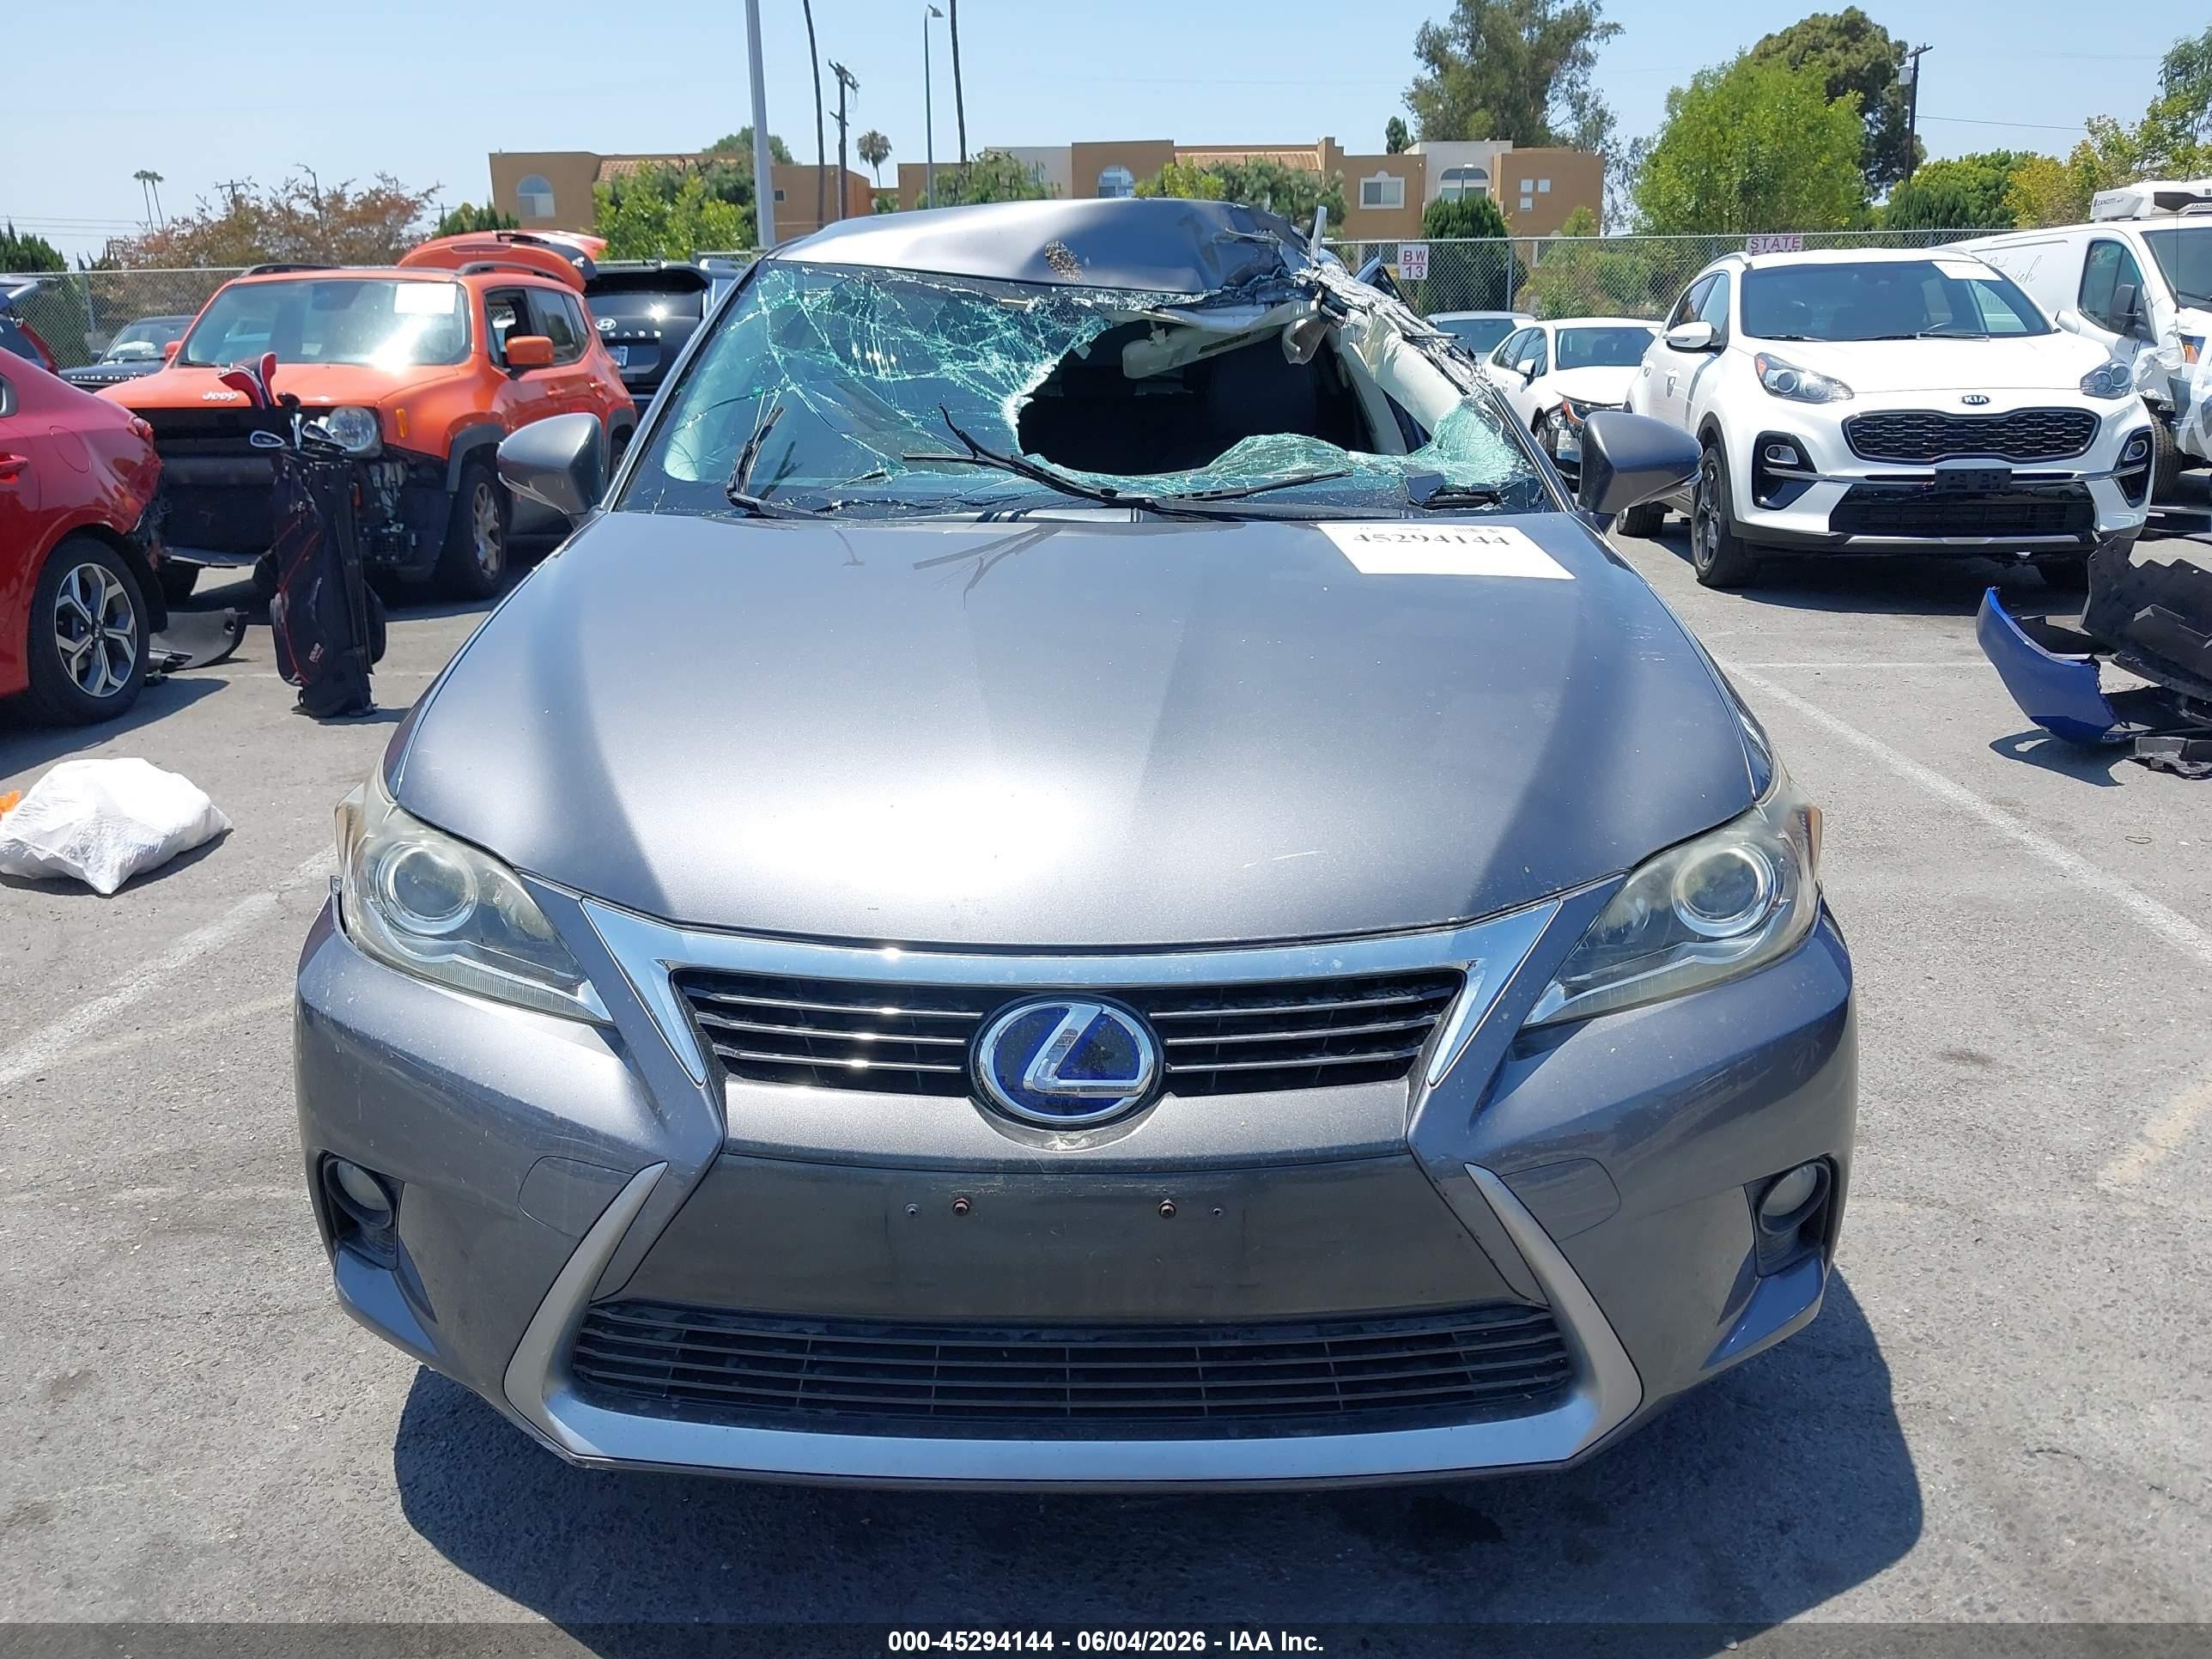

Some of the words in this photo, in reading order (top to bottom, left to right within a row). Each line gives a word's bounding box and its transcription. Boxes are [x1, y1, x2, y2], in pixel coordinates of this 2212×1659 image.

[1751, 236, 1801, 250] STATE
[1405, 265, 1425, 278] 13
[202, 391, 239, 402] Jeep
[1964, 395, 1988, 404] KIA
[1353, 533, 1510, 546] 45294144
